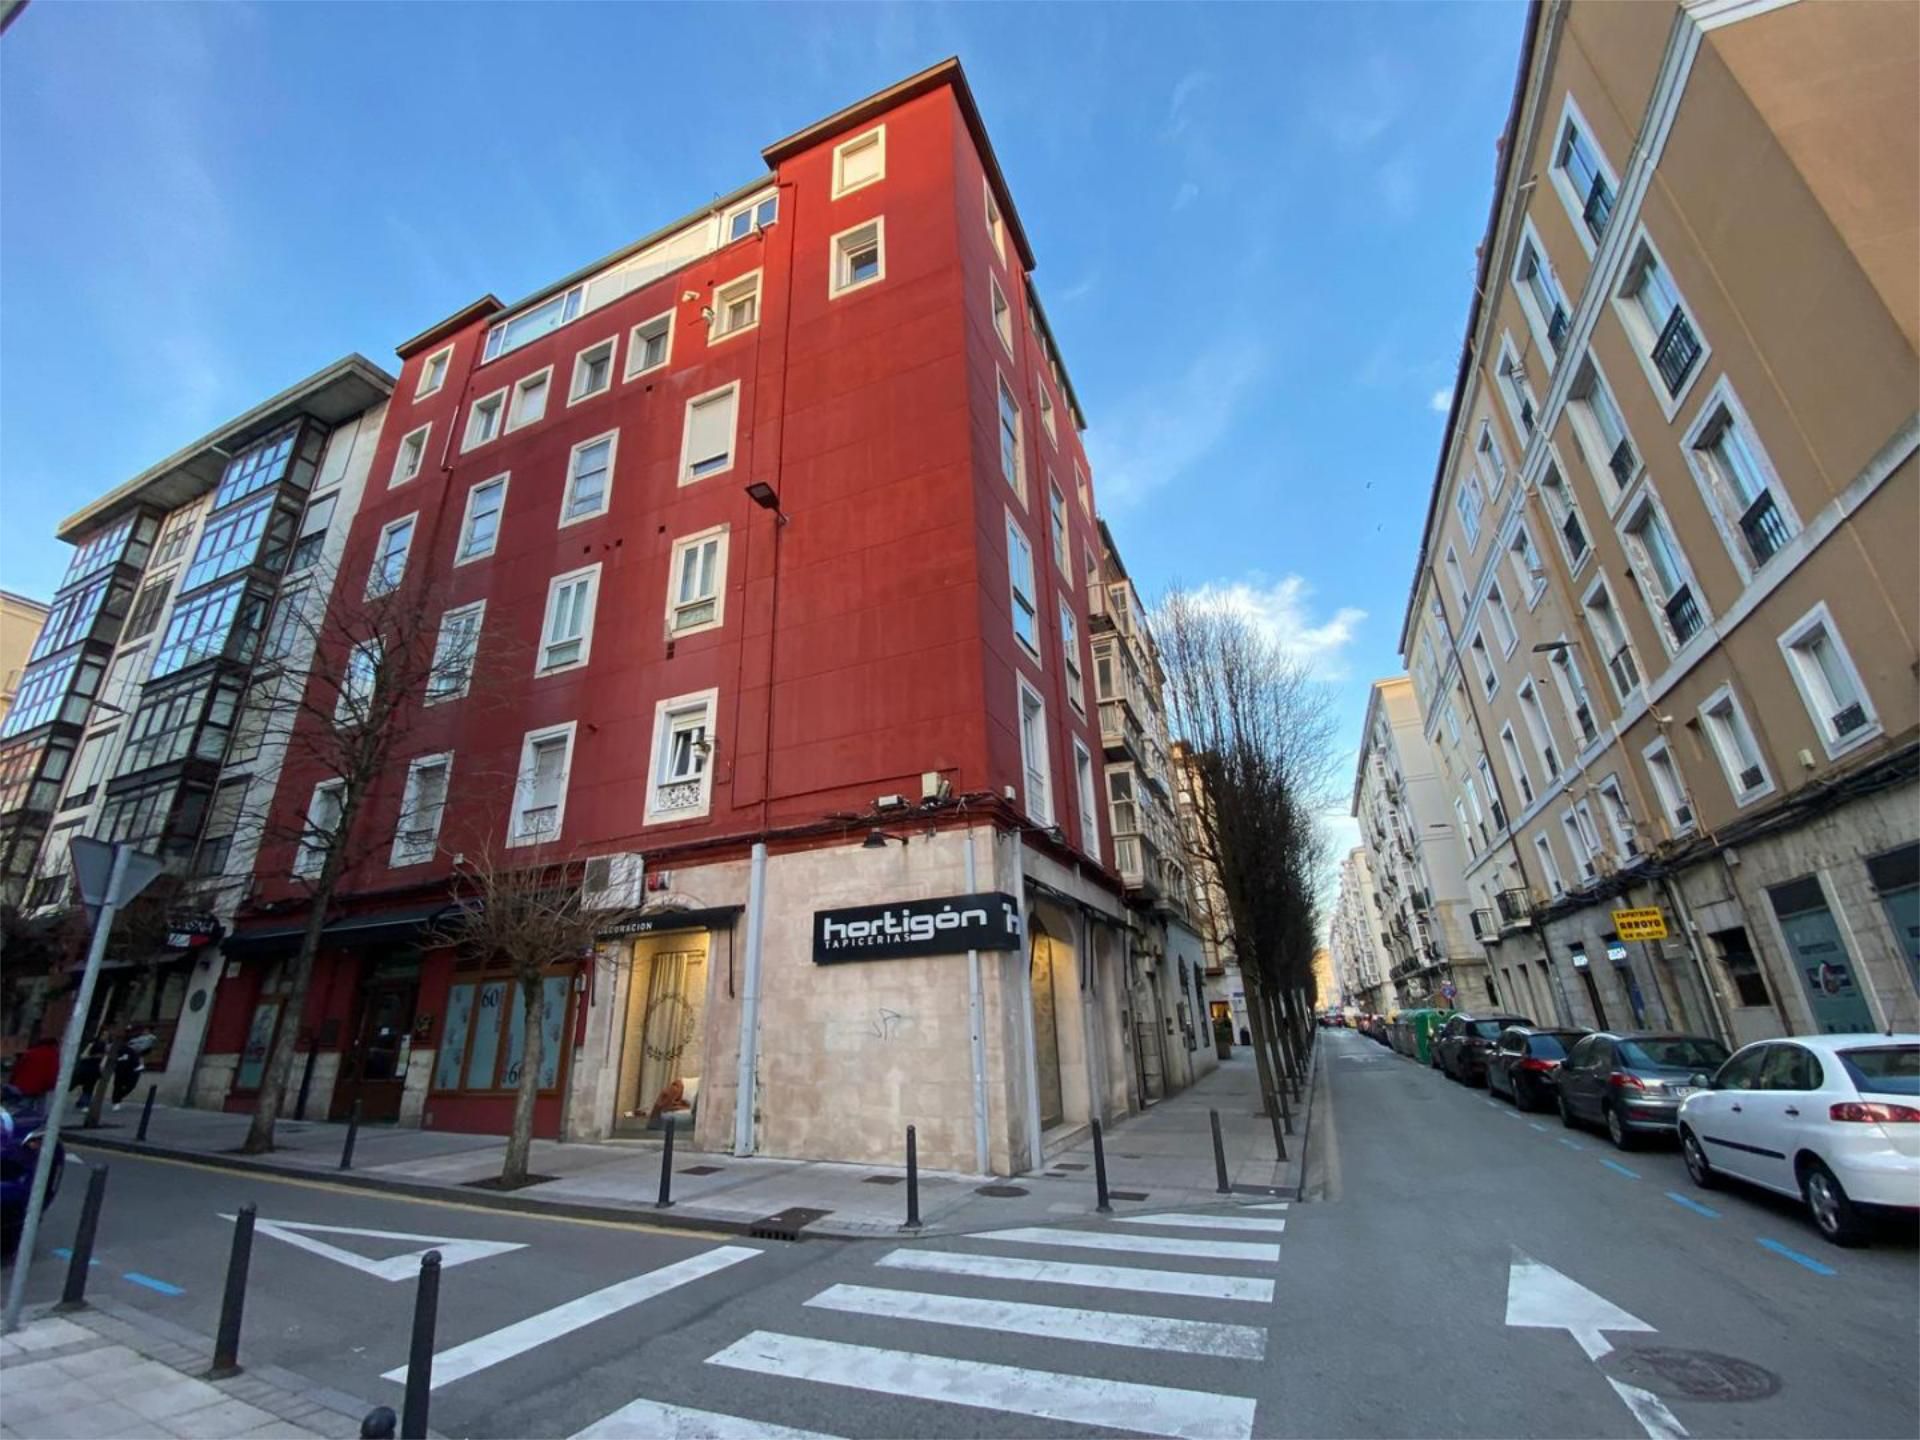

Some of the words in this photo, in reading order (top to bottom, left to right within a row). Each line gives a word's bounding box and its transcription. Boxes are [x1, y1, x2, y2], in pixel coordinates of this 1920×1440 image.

[824, 905, 988, 941] hortigón
[1620, 919, 1661, 929] ARROYO
[825, 932, 910, 949] TAPICERIAS
[481, 987, 499, 1008] 60
